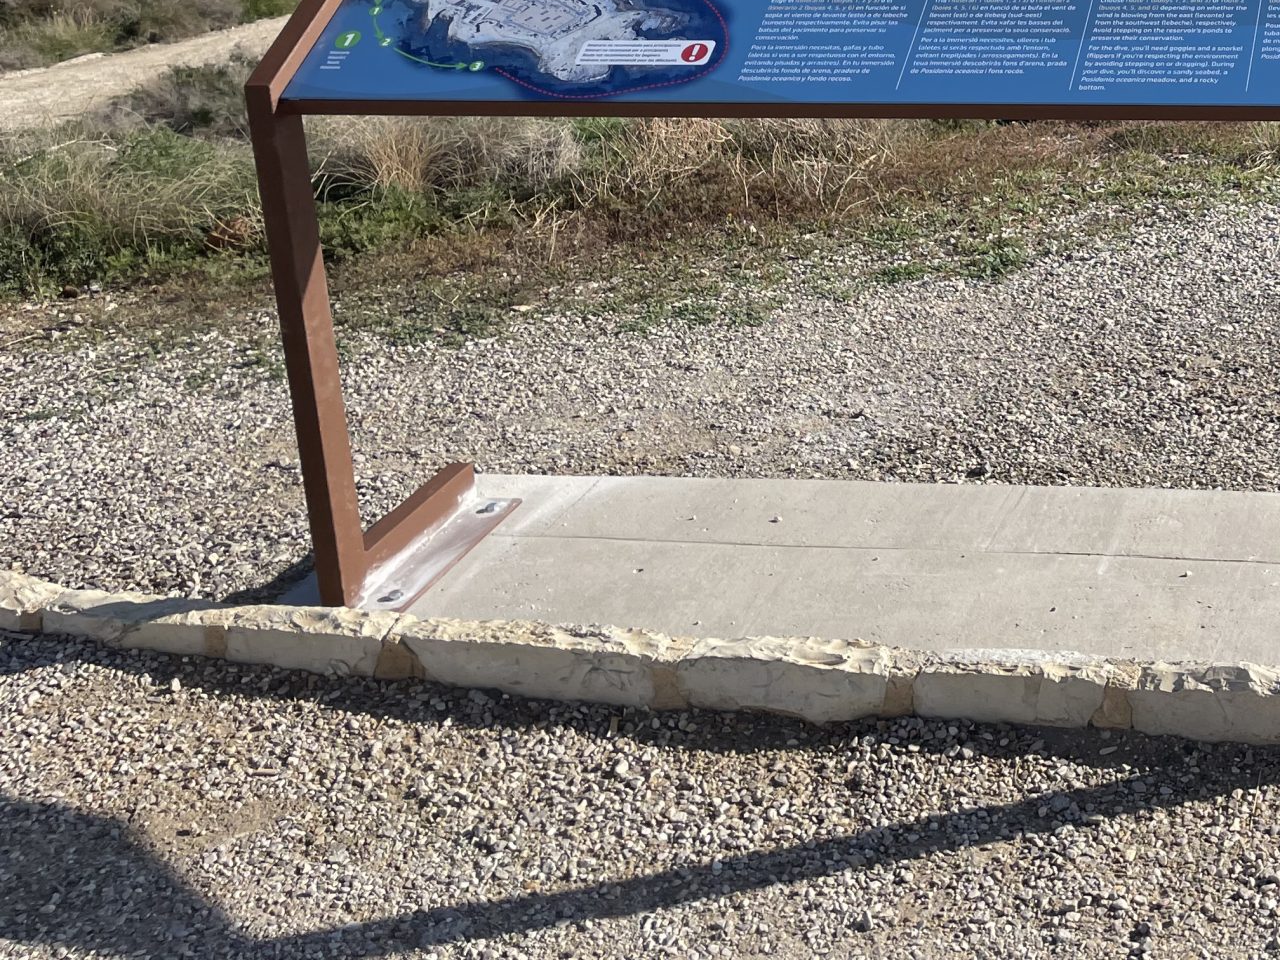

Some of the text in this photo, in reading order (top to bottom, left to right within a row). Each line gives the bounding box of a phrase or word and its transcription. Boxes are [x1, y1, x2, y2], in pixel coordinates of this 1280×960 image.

[343, 33, 355, 47] 1
[381, 38, 392, 46] 2
[474, 62, 482, 70] 3
